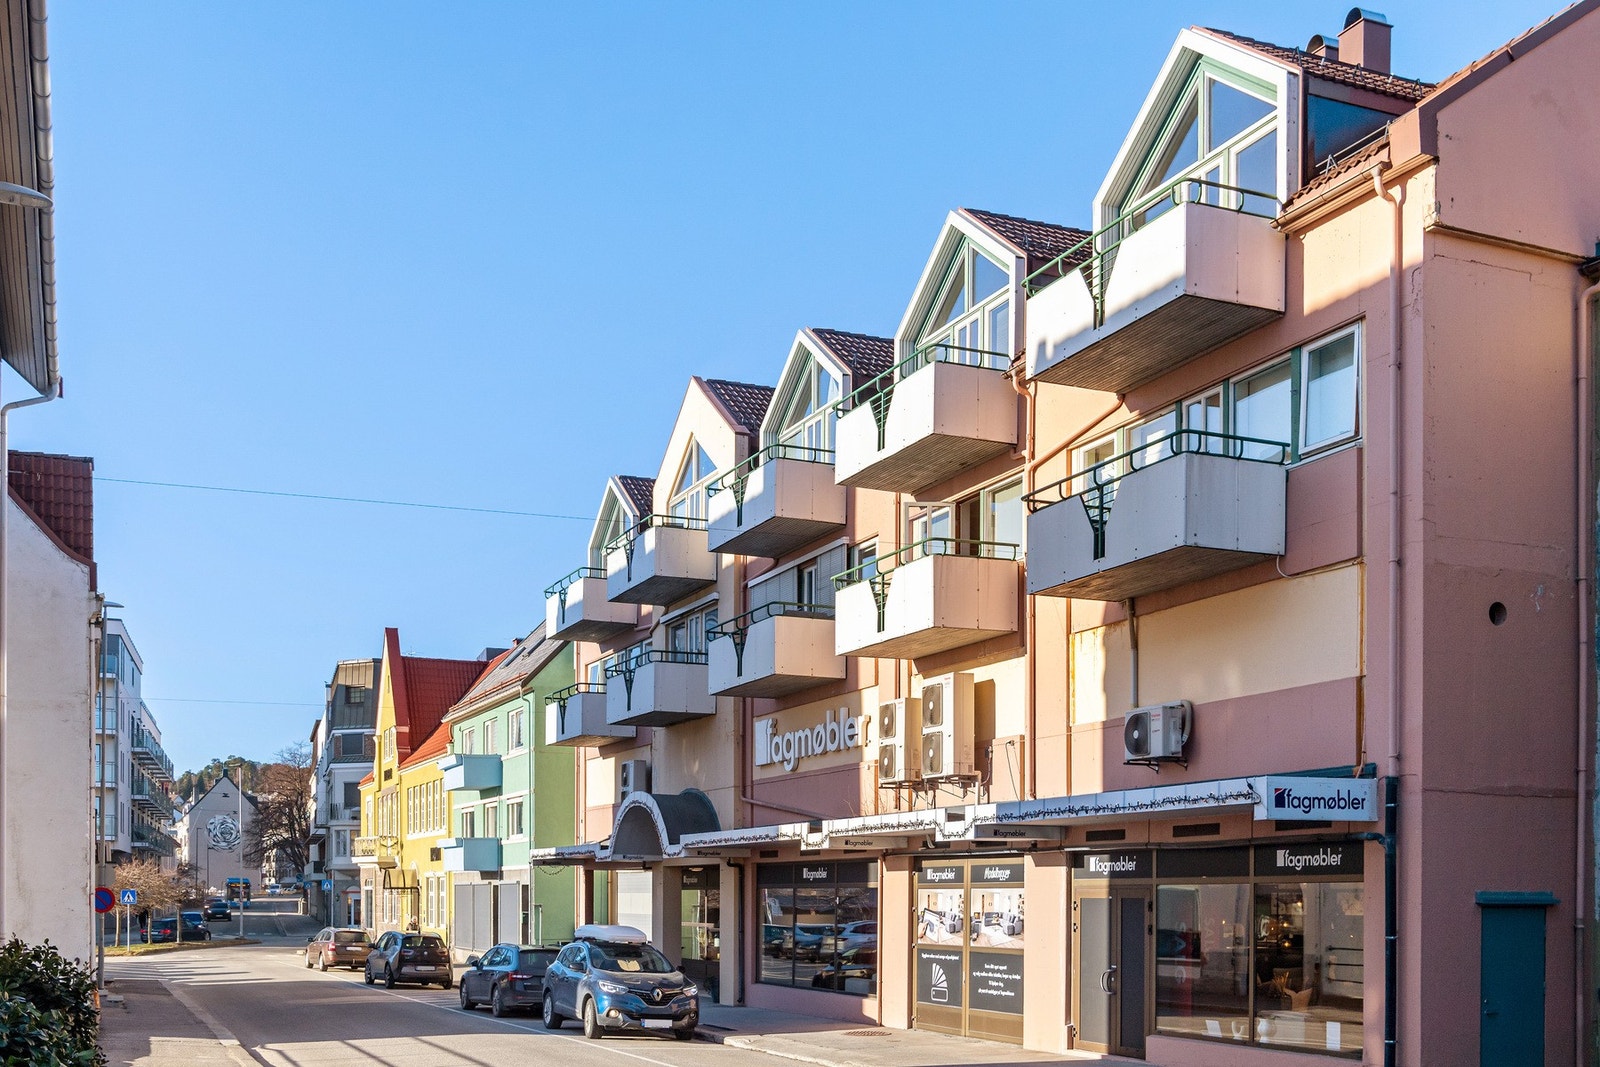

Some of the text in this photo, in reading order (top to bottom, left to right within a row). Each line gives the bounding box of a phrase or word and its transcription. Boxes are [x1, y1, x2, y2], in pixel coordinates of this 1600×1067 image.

[766, 707, 870, 772] fagmøbler
[1286, 788, 1366, 814] fagmøbler
[1095, 856, 1136, 875] fagmøbler
[1285, 848, 1342, 870] fagmøbler
